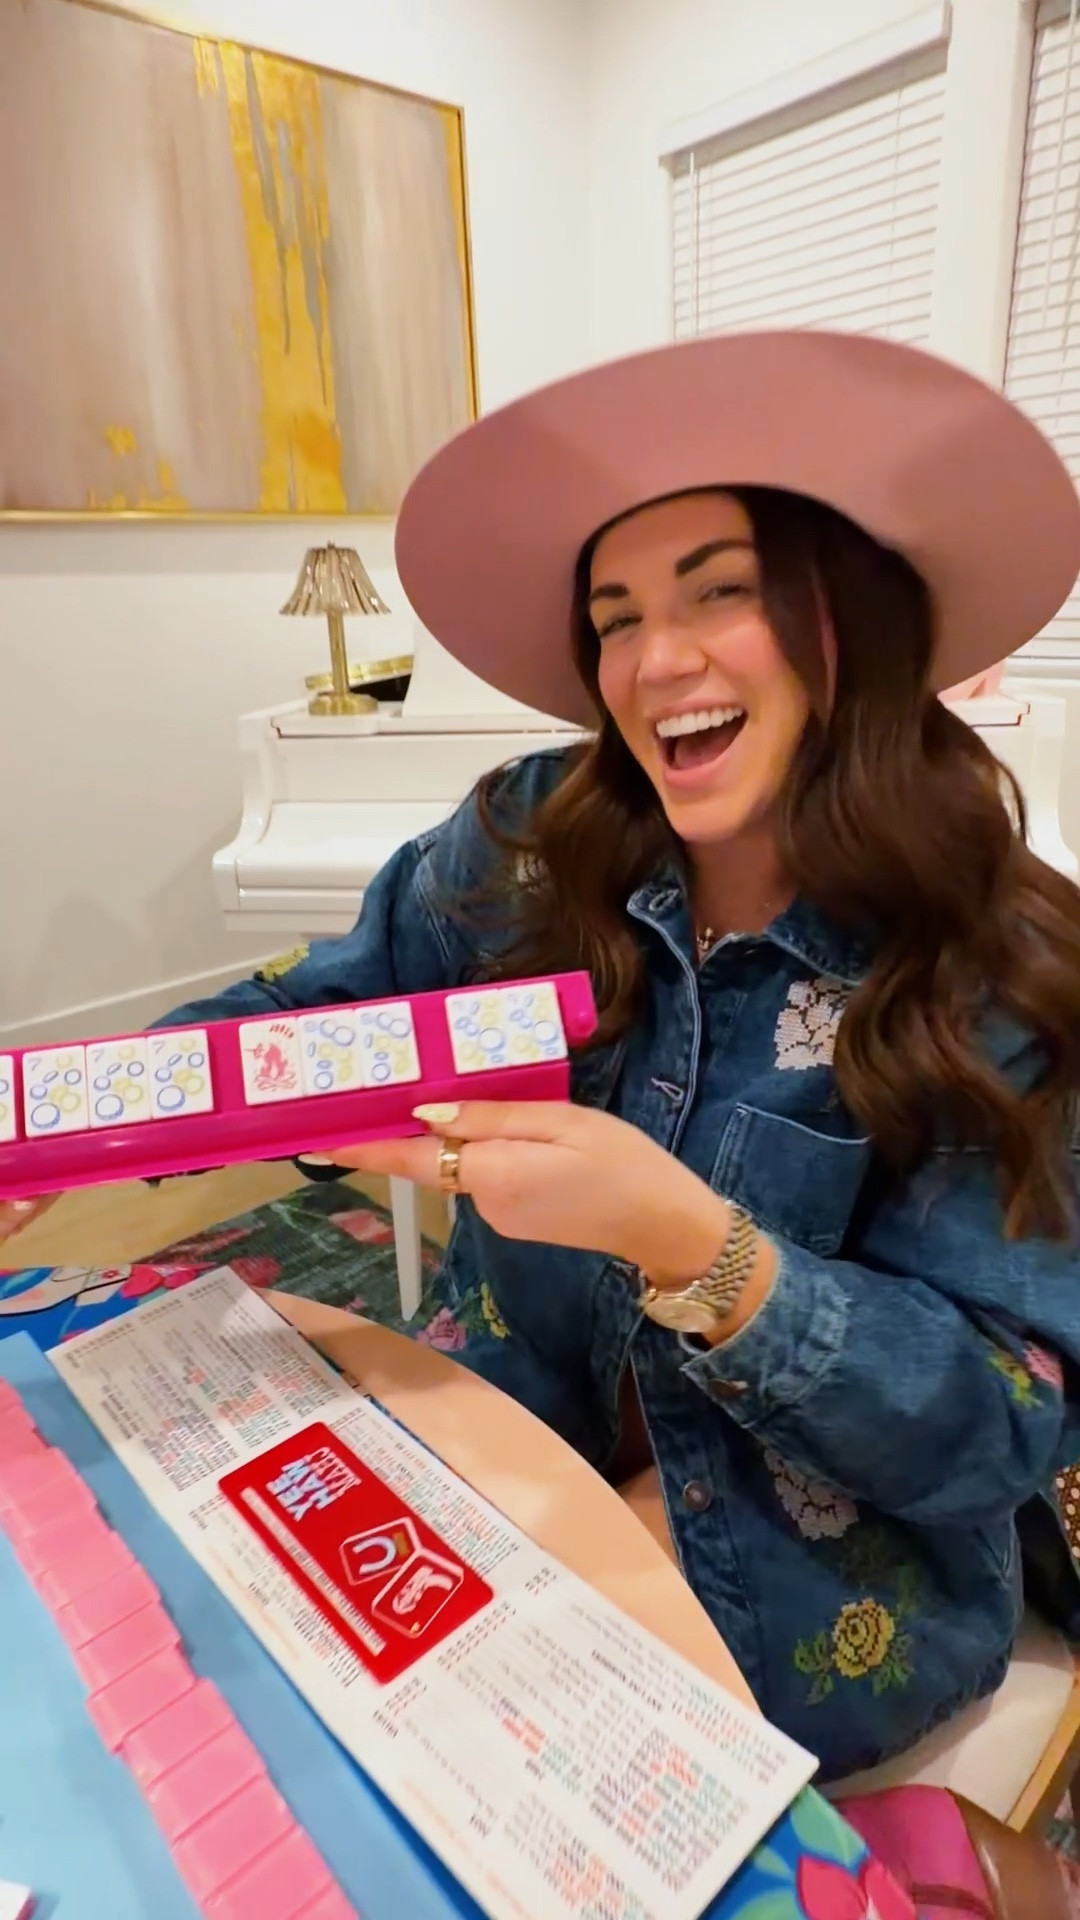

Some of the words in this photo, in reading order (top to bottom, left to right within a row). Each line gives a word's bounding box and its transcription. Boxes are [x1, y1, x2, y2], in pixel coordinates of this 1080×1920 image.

[266, 1472, 314, 1522] YEE
[281, 1457, 331, 1510] HAW
[303, 1447, 362, 1500] MAHJ
